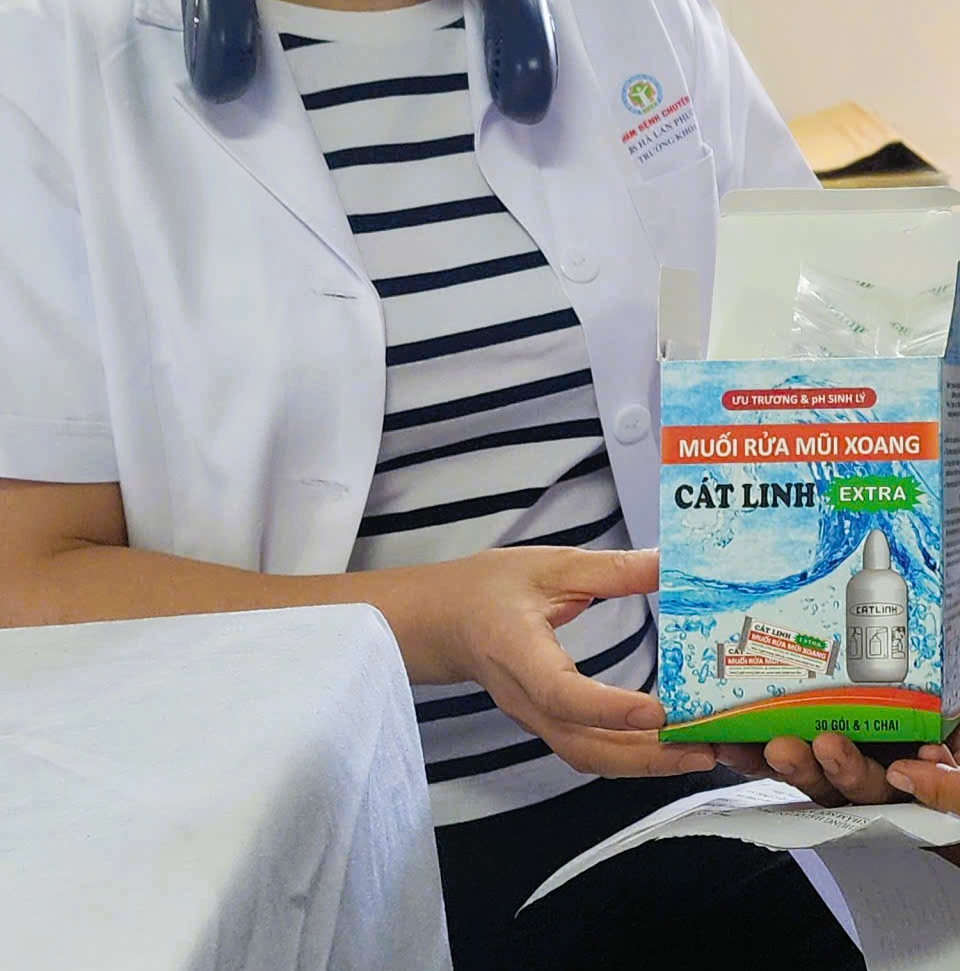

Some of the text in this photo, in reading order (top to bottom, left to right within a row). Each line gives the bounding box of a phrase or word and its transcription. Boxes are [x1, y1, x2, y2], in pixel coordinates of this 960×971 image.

[653, 122, 673, 139] LAN
[732, 391, 866, 405] ƯU TRƯƠNG & pH SINH LÝ
[679, 431, 920, 458] MUỐI RỬA MŨI XOANG
[675, 476, 907, 509] CÁT LINH EXTRA
[772, 630, 791, 640] LINH
[815, 716, 899, 732] 30 GÓI & 1 CHAI
